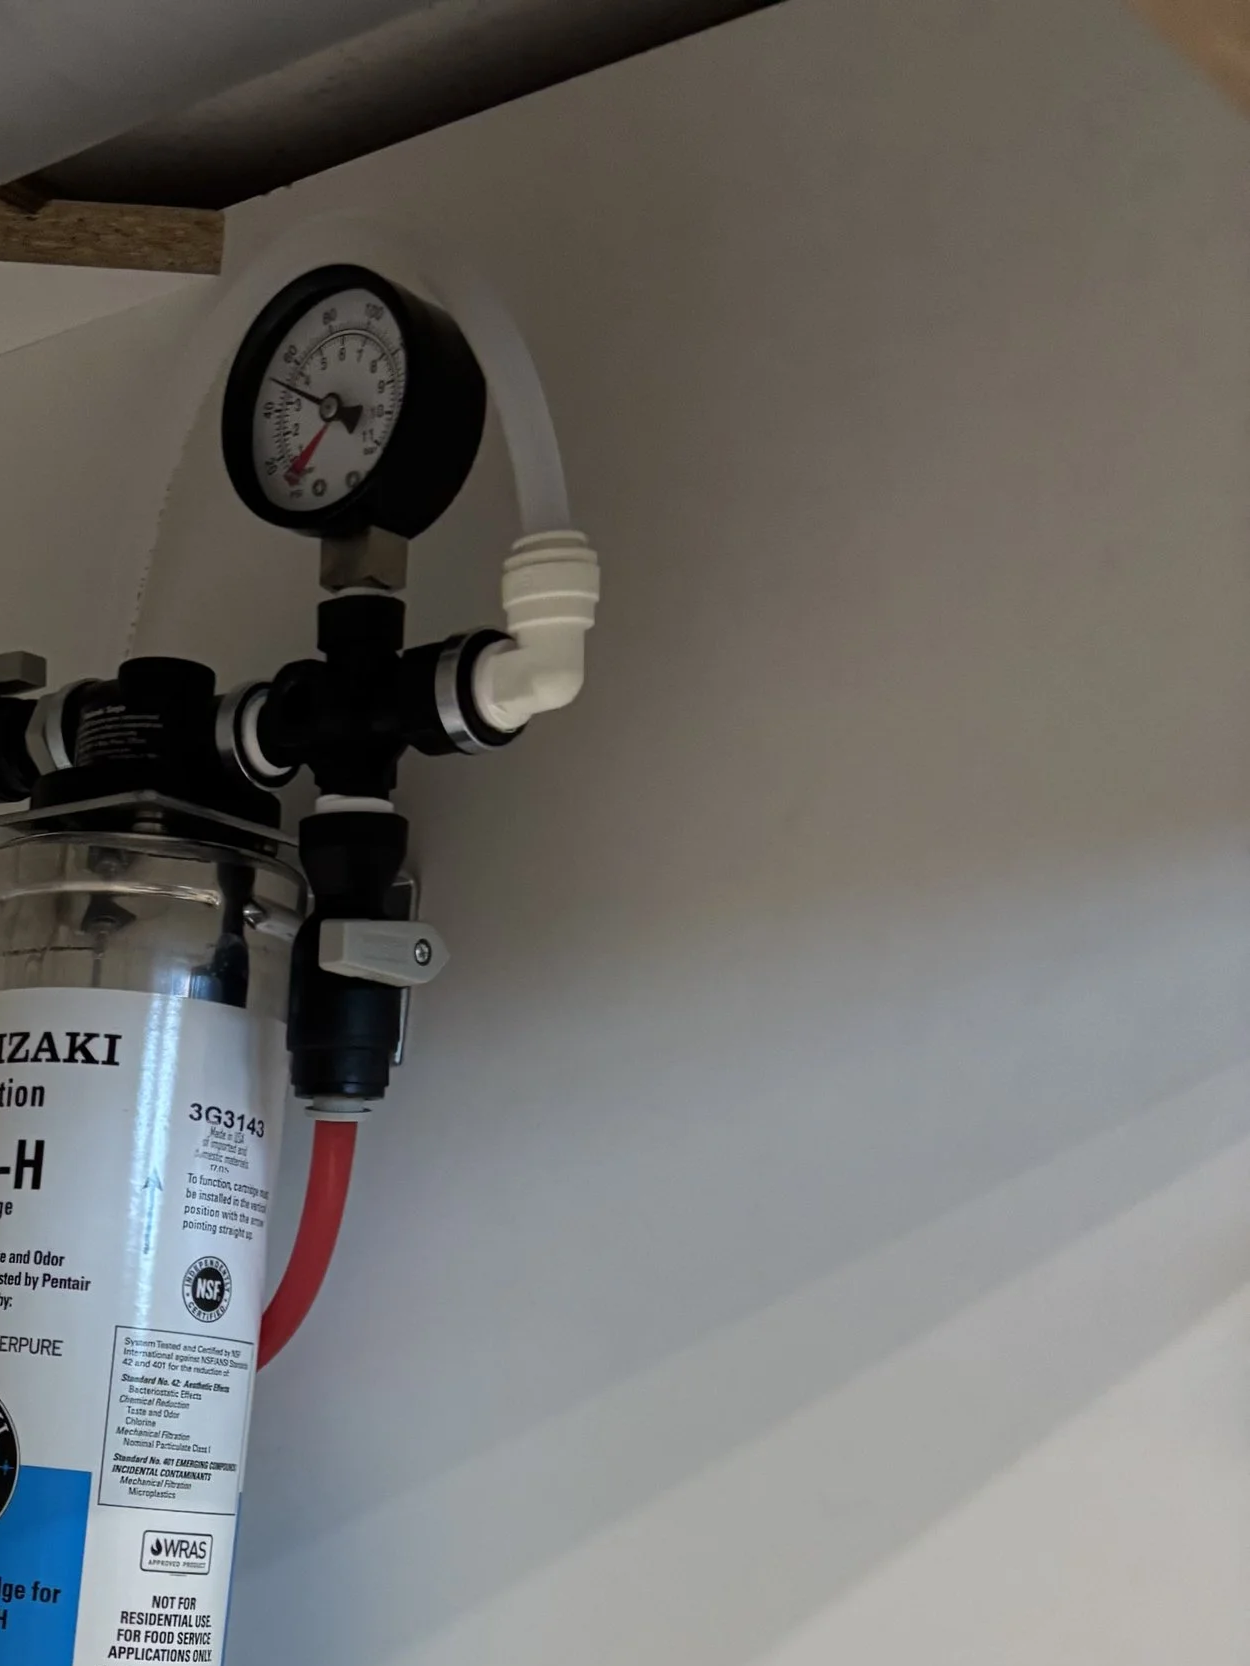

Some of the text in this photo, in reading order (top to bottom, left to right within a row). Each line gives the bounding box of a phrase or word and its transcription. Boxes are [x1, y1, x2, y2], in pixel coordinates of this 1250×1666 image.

[189, 1103, 264, 1138] 3G3143
[188, 1173, 198, 1184] To
[186, 1188, 197, 1199] be
[199, 1191, 232, 1205] installed
[184, 1204, 219, 1219] position
[222, 1210, 237, 1221] with
[183, 1220, 245, 1239] pointing straight
[9, 1251, 31, 1265] and
[34, 1250, 64, 1266] Odor
[25, 1274, 38, 1289] by
[42, 1274, 91, 1291] Pentair
[197, 1278, 221, 1300] NSF
[157, 1340, 196, 1352] Tested and
[122, 1358, 191, 1371] 42 and 401 for the
[122, 1374, 156, 1384] Standard
[119, 1395, 154, 1406] Chemical
[181, 1391, 201, 1400] Effects
[128, 1406, 180, 1419] Taste and Odor
[126, 1417, 156, 1427] Chlorine
[116, 1427, 160, 1438] Mechanical
[123, 1438, 153, 1448] Nominal
[113, 1453, 148, 1464] Standard
[112, 1465, 212, 1481] INCIDENTAL CONTAMINANTS
[120, 1476, 163, 1487] Mechanical
[129, 1487, 175, 1499] Microplastics
[164, 1538, 206, 1559] WRAS
[149, 1560, 180, 1568] APPROVED
[32, 1580, 61, 1603] for
[152, 1595, 196, 1610] NOT FOR
[120, 1611, 193, 1628] RESIDENTIAL
[117, 1629, 211, 1645] FOR FOOD SERVICE
[108, 1646, 190, 1662] APPLICATIONS
